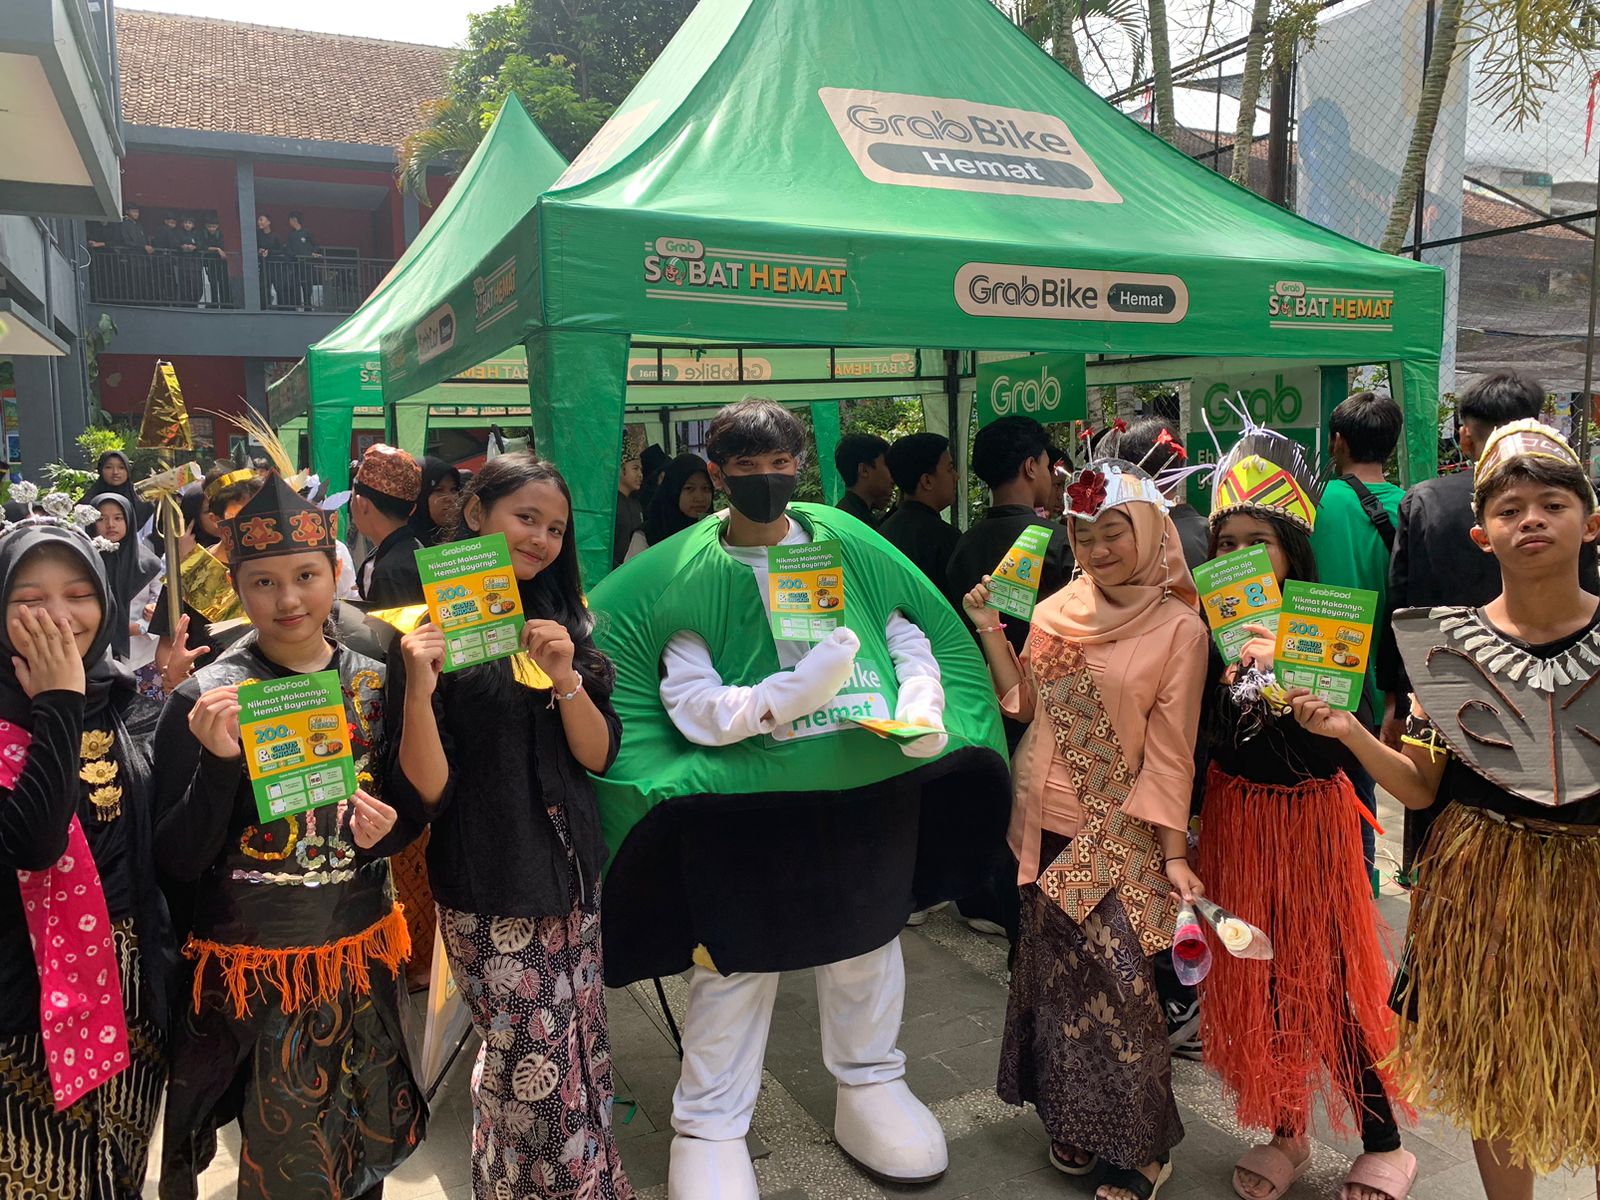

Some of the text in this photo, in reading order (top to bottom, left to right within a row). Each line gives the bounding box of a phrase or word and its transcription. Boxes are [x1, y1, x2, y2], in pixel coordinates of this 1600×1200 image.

[846, 104, 1072, 155] GrabBike
[921, 151, 1045, 180] Hemat
[665, 240, 696, 254] Grab
[749, 263, 848, 295] HEMAT
[1281, 282, 1301, 293] Grab
[969, 274, 1164, 309] GrabBike Hemat
[1332, 297, 1393, 320] HEMAT
[990, 365, 1061, 416] Grab
[1204, 374, 1302, 427] Grab
[441, 541, 482, 557] GrabFood
[428, 559, 457, 571] Nikmat
[434, 559, 497, 577] Hemat Bayarnya
[1016, 557, 1032, 580] 8
[1245, 583, 1267, 607] 8
[1292, 596, 1320, 606] Nikmat
[1309, 587, 1351, 599] GrabFood
[1294, 605, 1360, 619] Hemat Bayarnya
[263, 678, 310, 694] GrabFood
[247, 688, 330, 709] Nikmat Makannya,
[253, 696, 327, 717] Hemat Bayarnya
